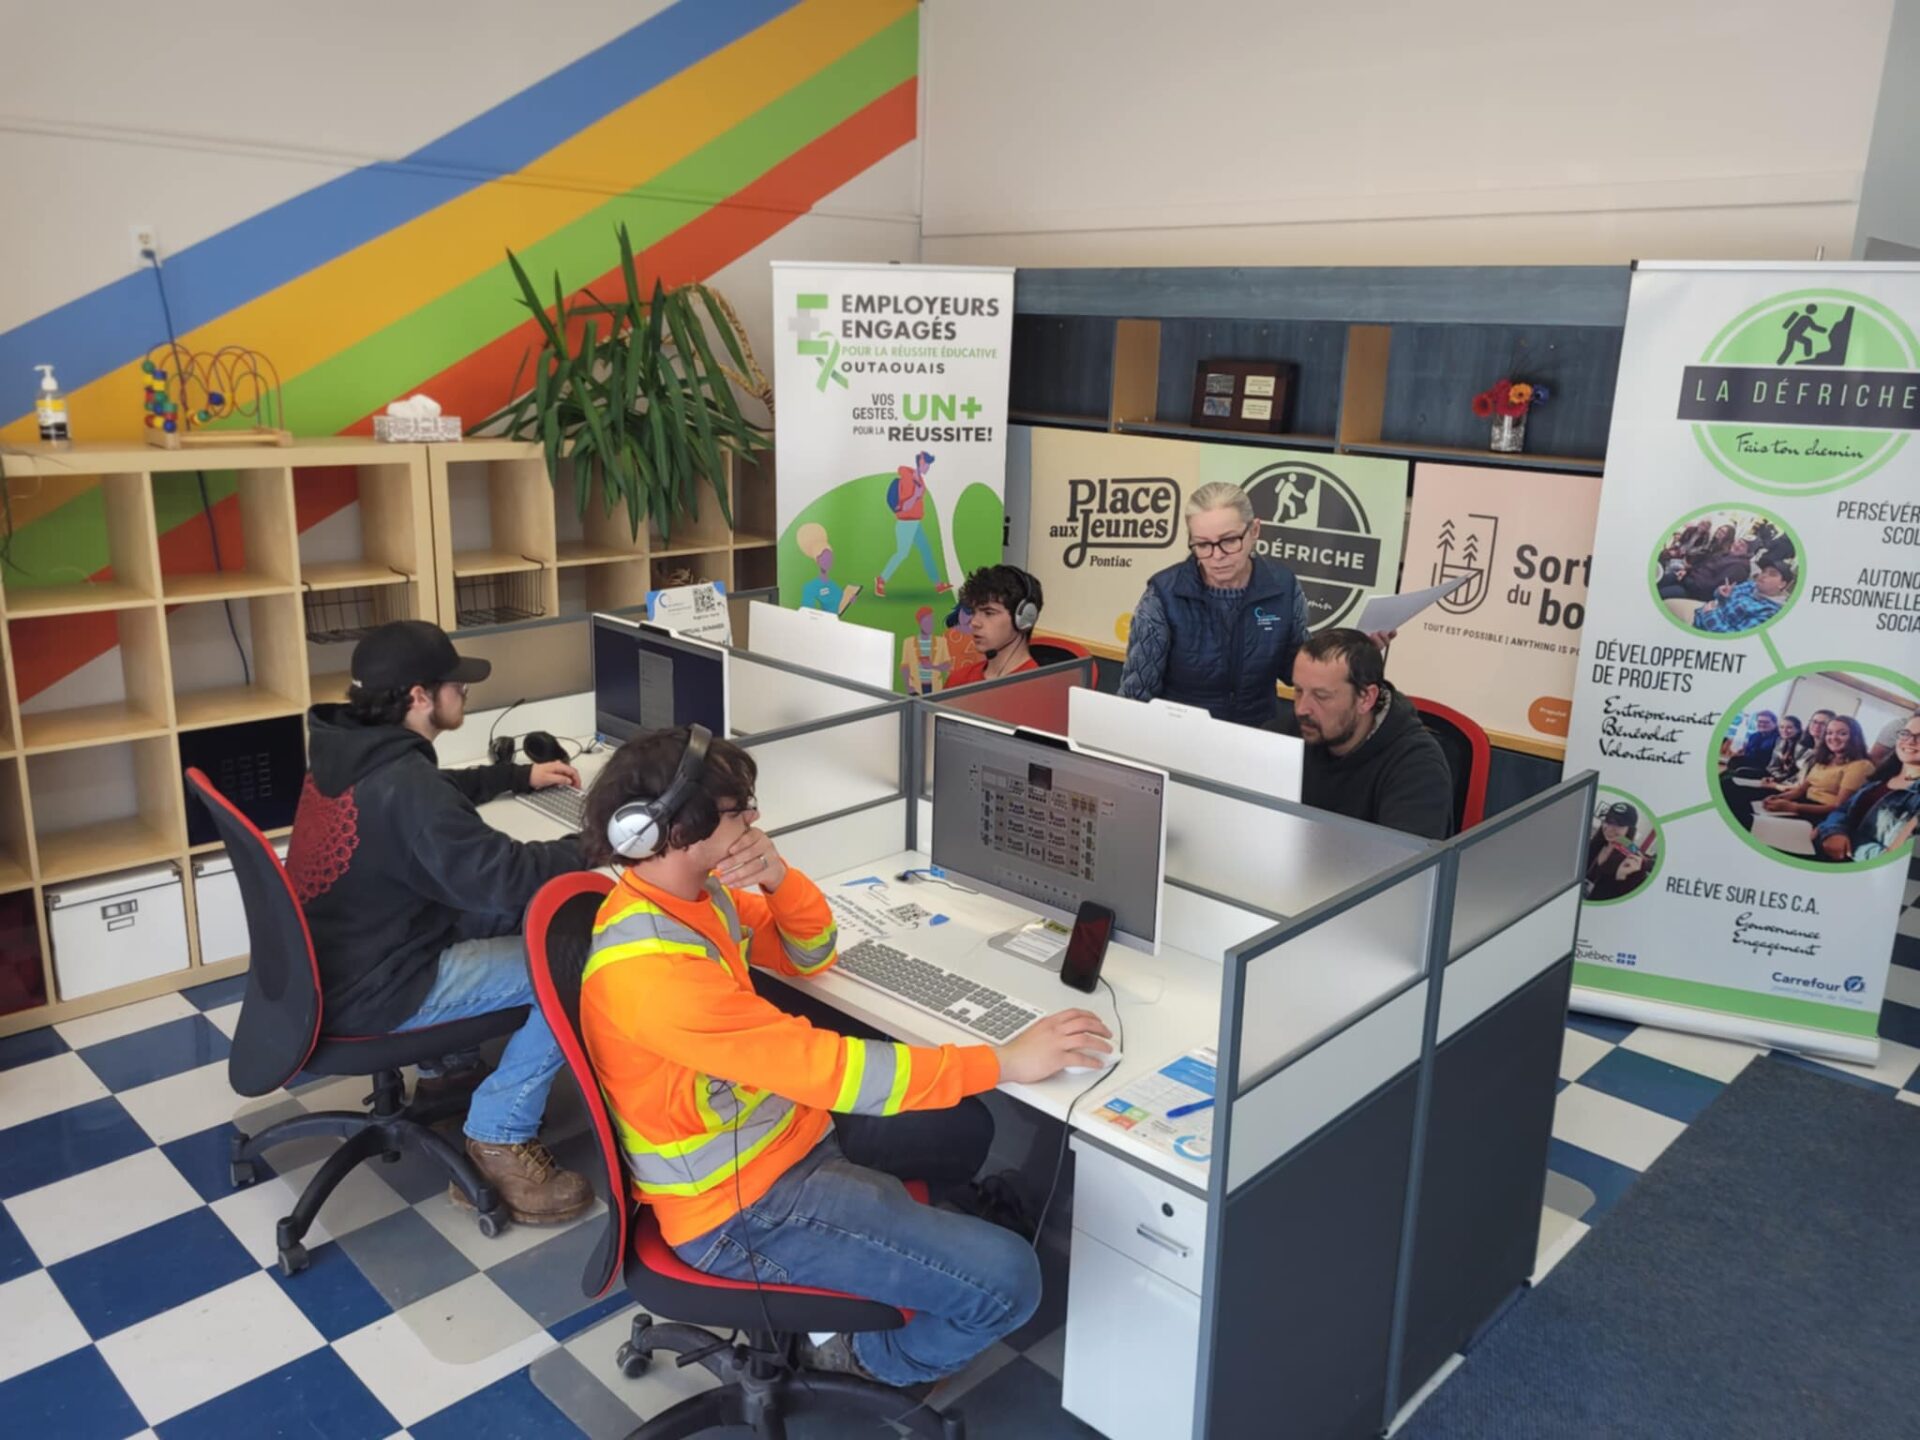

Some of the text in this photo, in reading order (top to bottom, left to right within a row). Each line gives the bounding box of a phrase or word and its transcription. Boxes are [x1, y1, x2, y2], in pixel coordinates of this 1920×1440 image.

[842, 294, 999, 317] EMPLOYEURS
[842, 316, 956, 340] ENGAGÉS
[841, 345, 998, 359] POUR LA RÉUSSITE ÉDUCATIVE
[841, 362, 945, 374] OUTAOUAIS
[872, 393, 895, 406] VOS
[1696, 378, 1918, 409] LA DÉFRICHE
[853, 424, 992, 442] POUR LA RÉUSSITE!
[1736, 432, 1863, 458] Fais ton chemin
[1067, 479, 1171, 523] Place
[1837, 500, 1920, 524] PERSÉVÉR
[1049, 525, 1079, 538] aux
[1882, 526, 1920, 546] SCOL
[1090, 555, 1132, 568] Pontiac
[1255, 538, 1366, 570] DÉFRICHE
[1507, 584, 1585, 630] du bo
[1811, 585, 1920, 612] PERSONNELLE
[1423, 622, 1444, 633] TOUT
[1445, 627, 1461, 636] EST
[1462, 629, 1502, 643] POSSIBLE
[1510, 637, 1556, 652] ANYTHING
[1558, 644, 1568, 654] IS
[1595, 638, 1747, 674] DÉVELOPPEMENT
[1592, 663, 1693, 693] DE PROJETS
[1599, 738, 1691, 764] Volontariat
[1665, 876, 1820, 914] RELÈVE SUR LES C.A.
[1772, 971, 1841, 992] Carrefour
